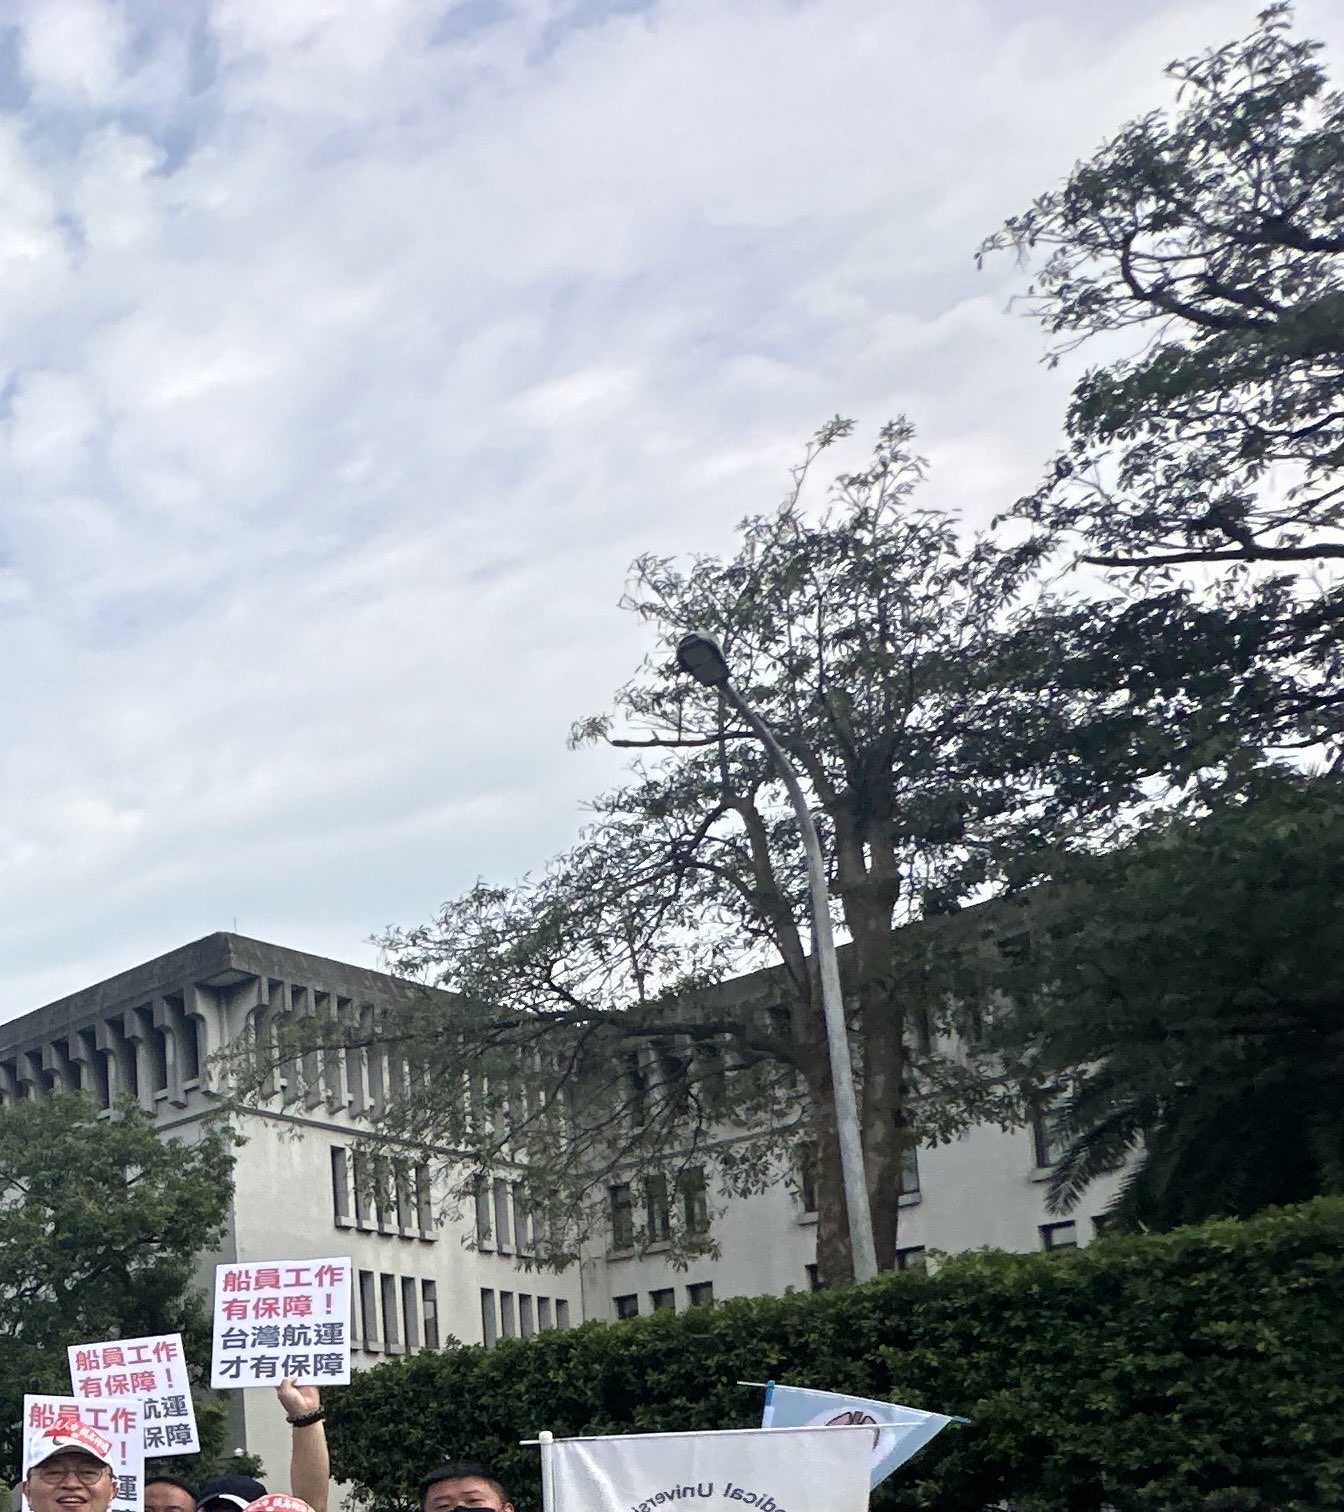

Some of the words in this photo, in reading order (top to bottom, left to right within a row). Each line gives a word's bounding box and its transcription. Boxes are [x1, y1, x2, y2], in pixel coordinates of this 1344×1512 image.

[222, 1264, 345, 1292] 船員工作
[222, 1294, 332, 1320] 有保障！
[221, 1322, 344, 1350] 台灣航運
[75, 1341, 178, 1371] 船員工作
[219, 1353, 344, 1379] 才有保障
[79, 1368, 174, 1397] 有保障！
[29, 1402, 137, 1434] 船員工作
